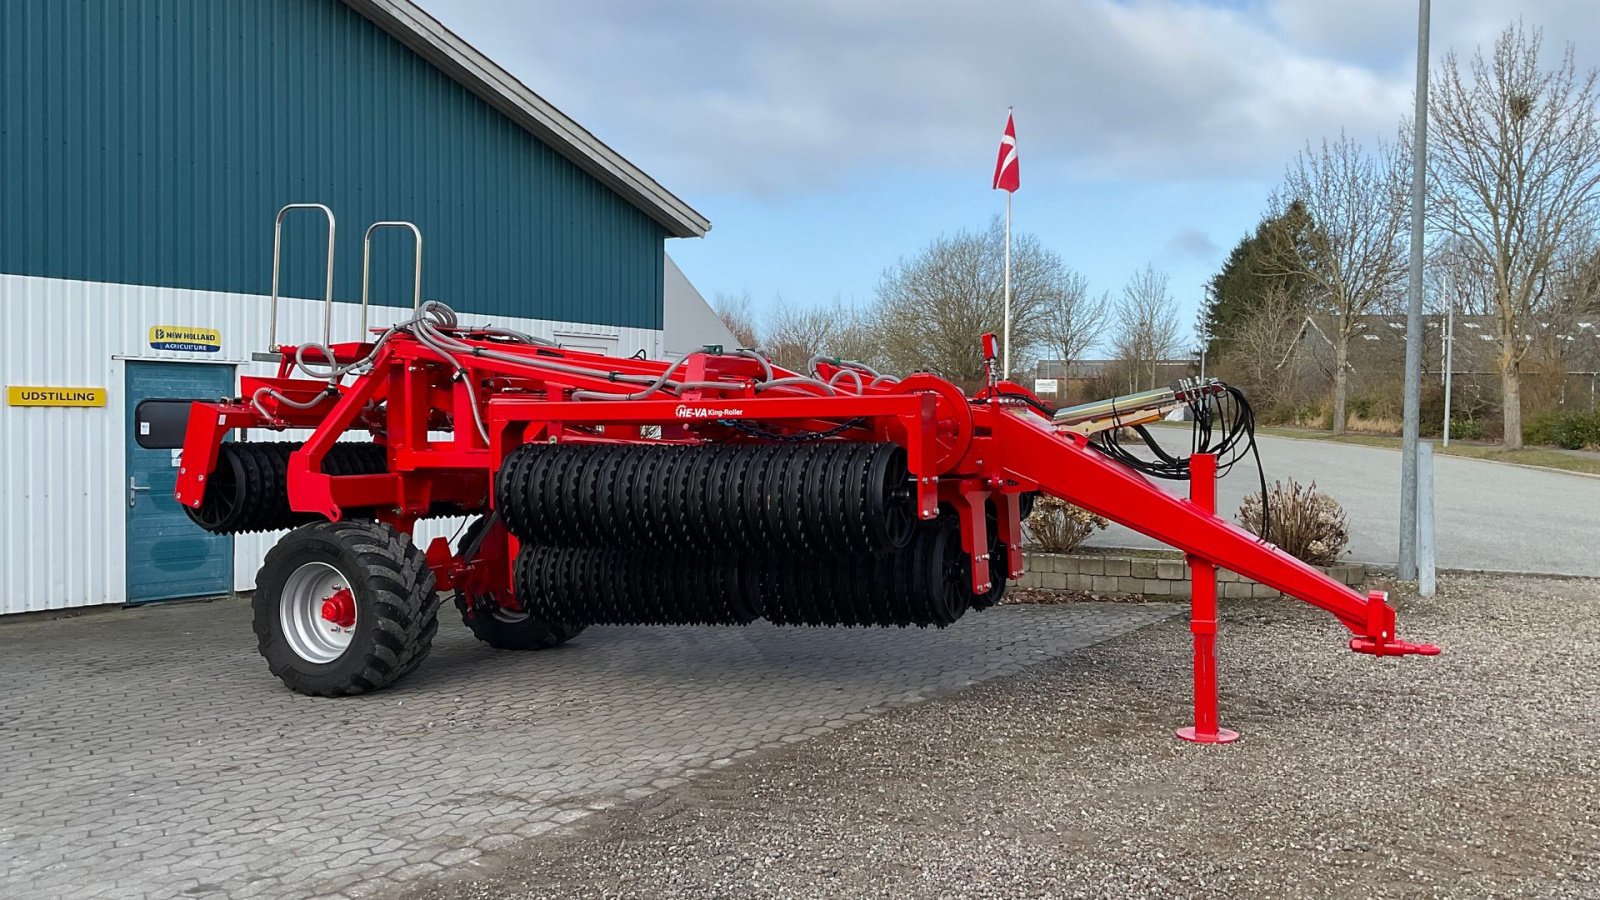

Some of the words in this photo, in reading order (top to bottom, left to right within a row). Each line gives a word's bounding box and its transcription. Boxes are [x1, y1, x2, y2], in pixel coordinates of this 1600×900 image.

[184, 333, 216, 341] HOLLAND
[165, 343, 207, 351] AGRICULTURE
[21, 391, 95, 401] UDSTILLING
[678, 408, 708, 418] HE-VA
[708, 409, 743, 417] King-Roller
